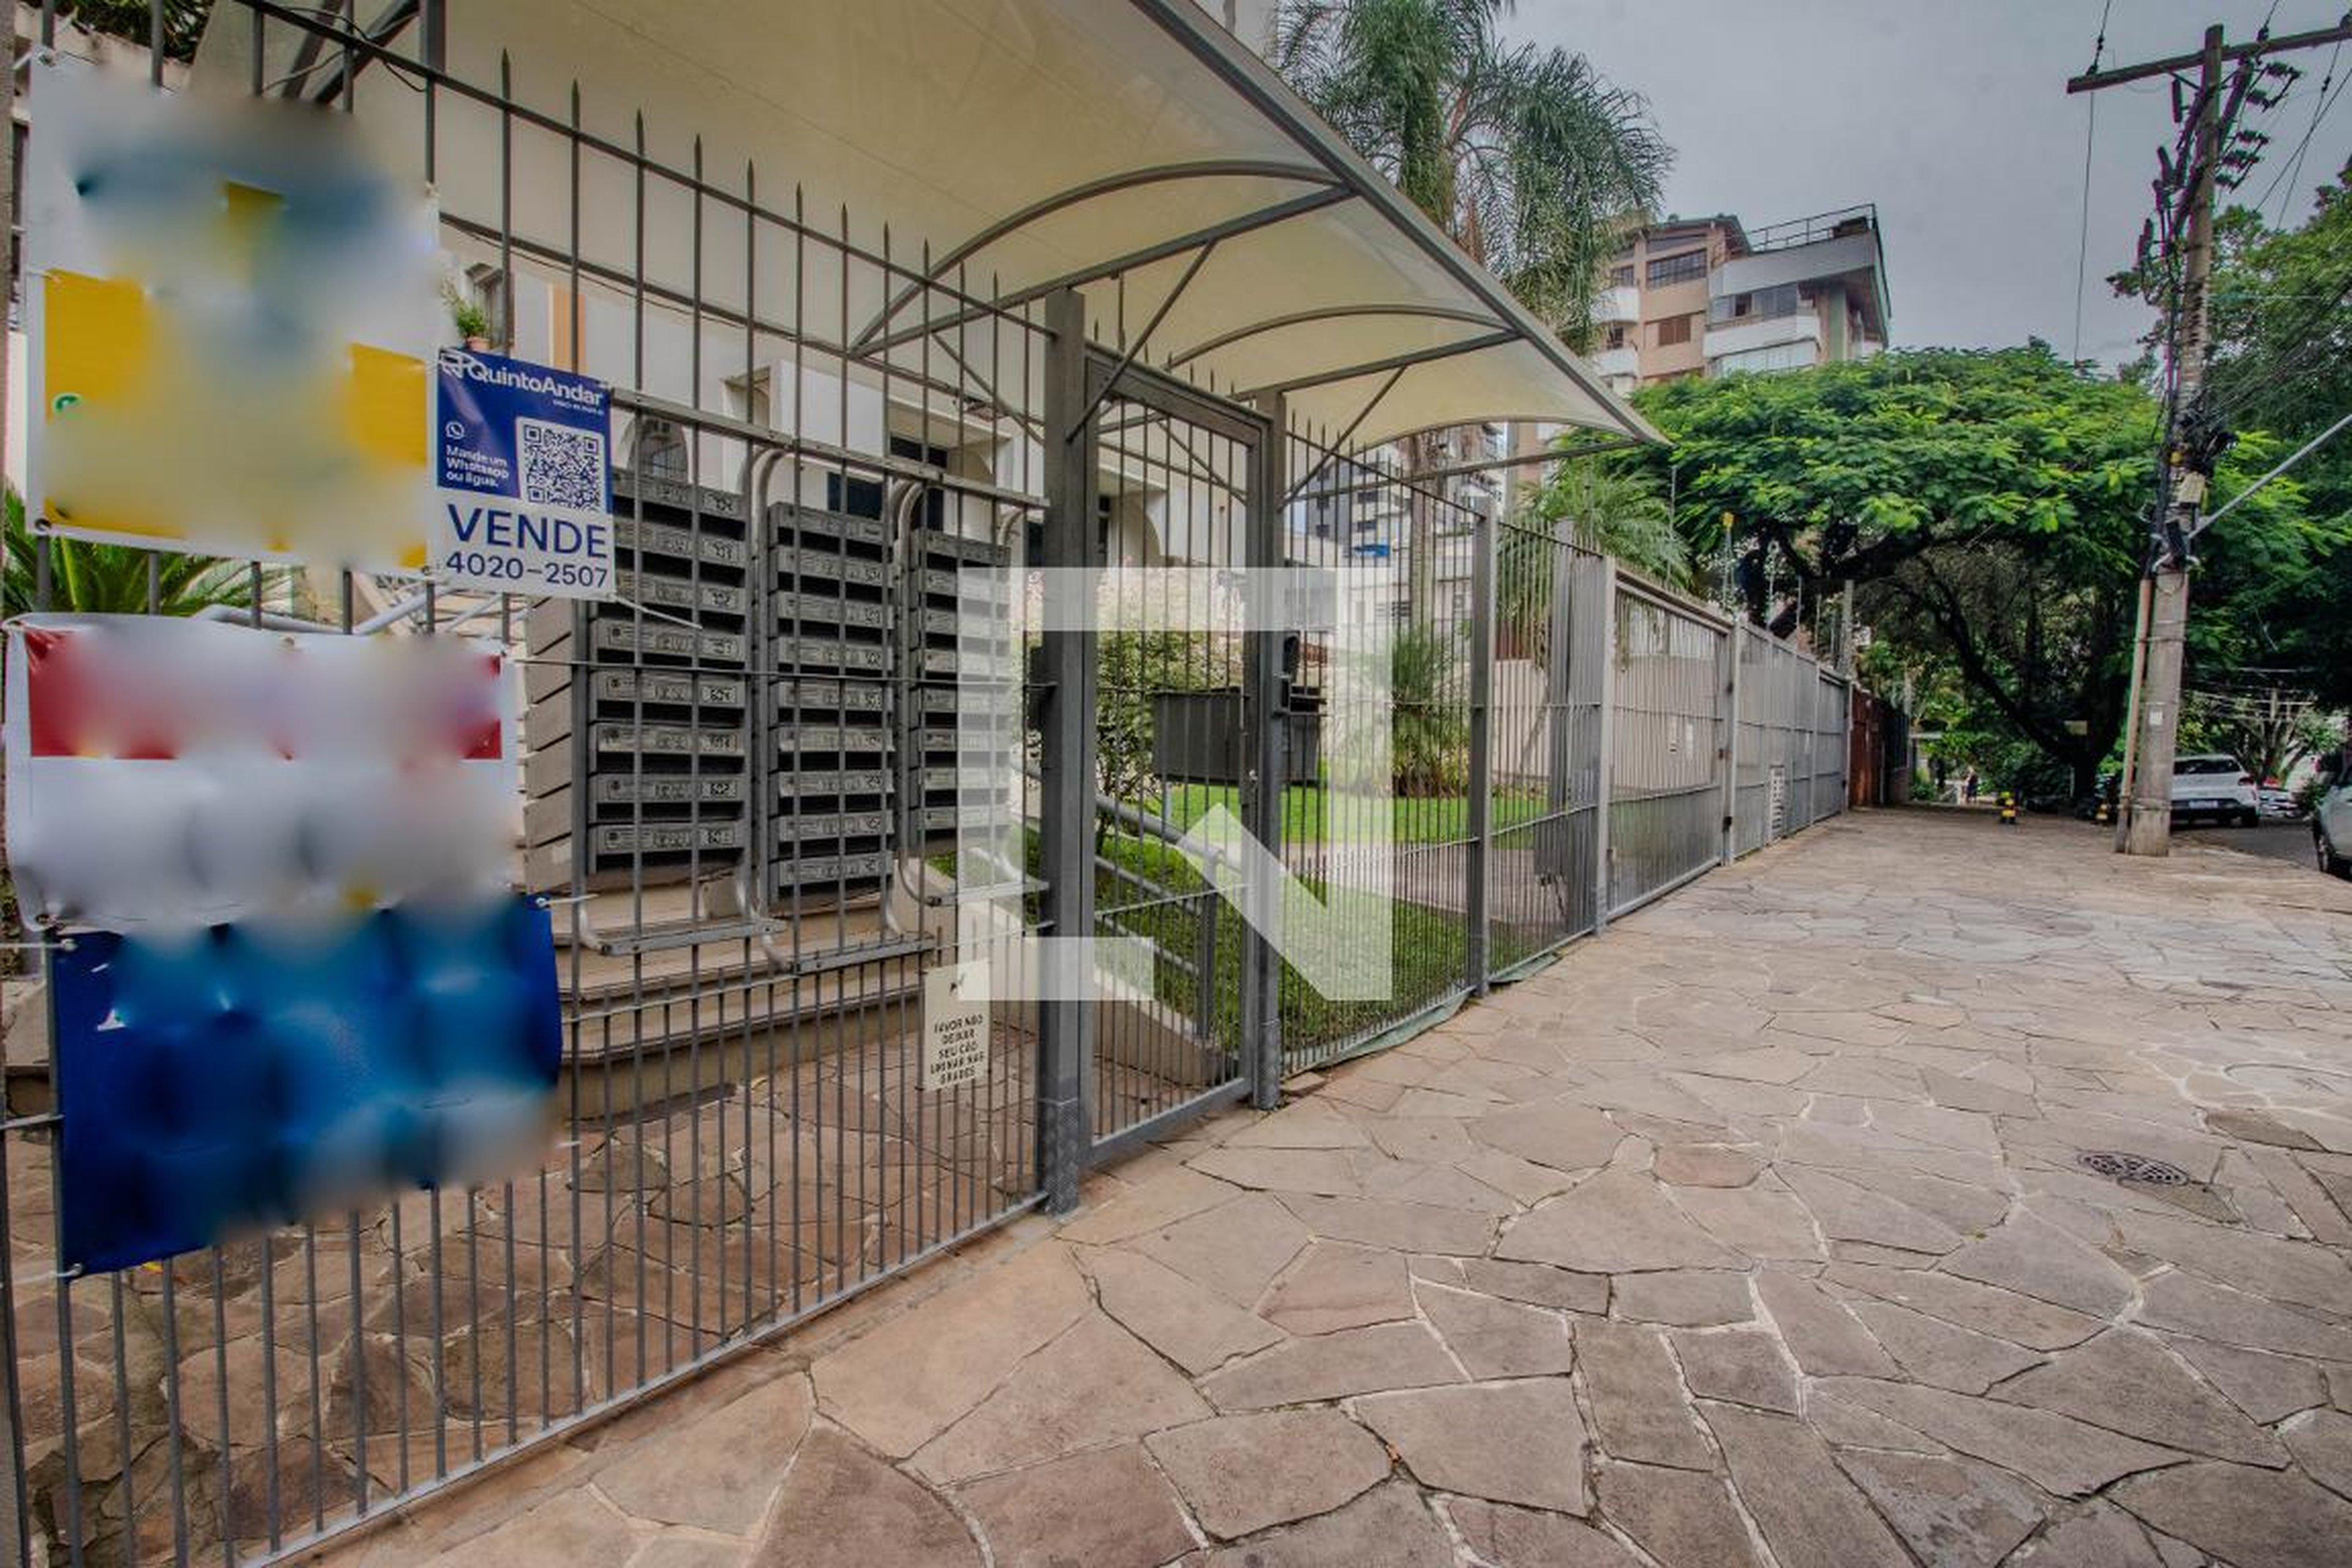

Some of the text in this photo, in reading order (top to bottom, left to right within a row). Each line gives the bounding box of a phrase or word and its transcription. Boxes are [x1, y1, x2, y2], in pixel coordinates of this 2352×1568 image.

[467, 361, 604, 406] QuintoAndar
[446, 471, 464, 481] ou
[447, 504, 607, 559] VENDE
[447, 551, 608, 588] 4020-2507
